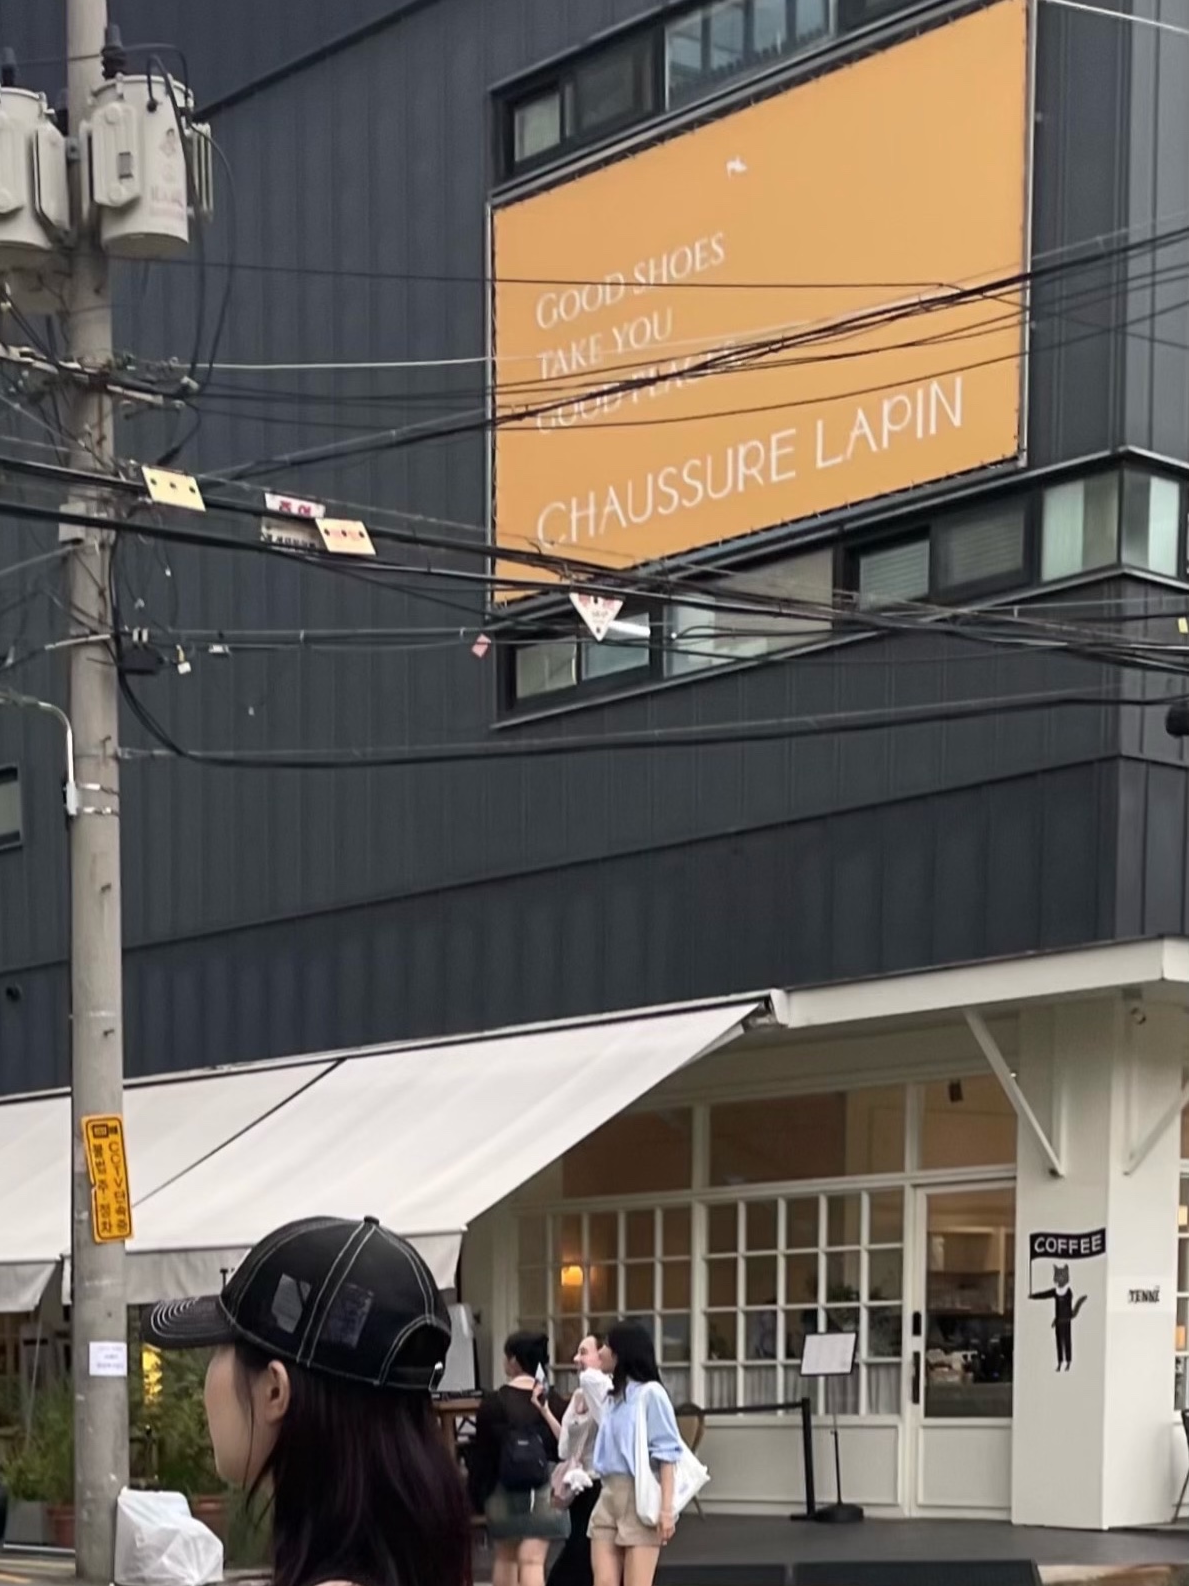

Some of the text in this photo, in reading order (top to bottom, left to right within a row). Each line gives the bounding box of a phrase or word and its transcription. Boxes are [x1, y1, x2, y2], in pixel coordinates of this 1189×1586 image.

[536, 231, 725, 329] GOOD SHOES
[536, 306, 673, 380] TAKE YOU
[536, 375, 963, 549] CHAUSSURE LAPIN
[1033, 1234, 1103, 1255] COFFEE
